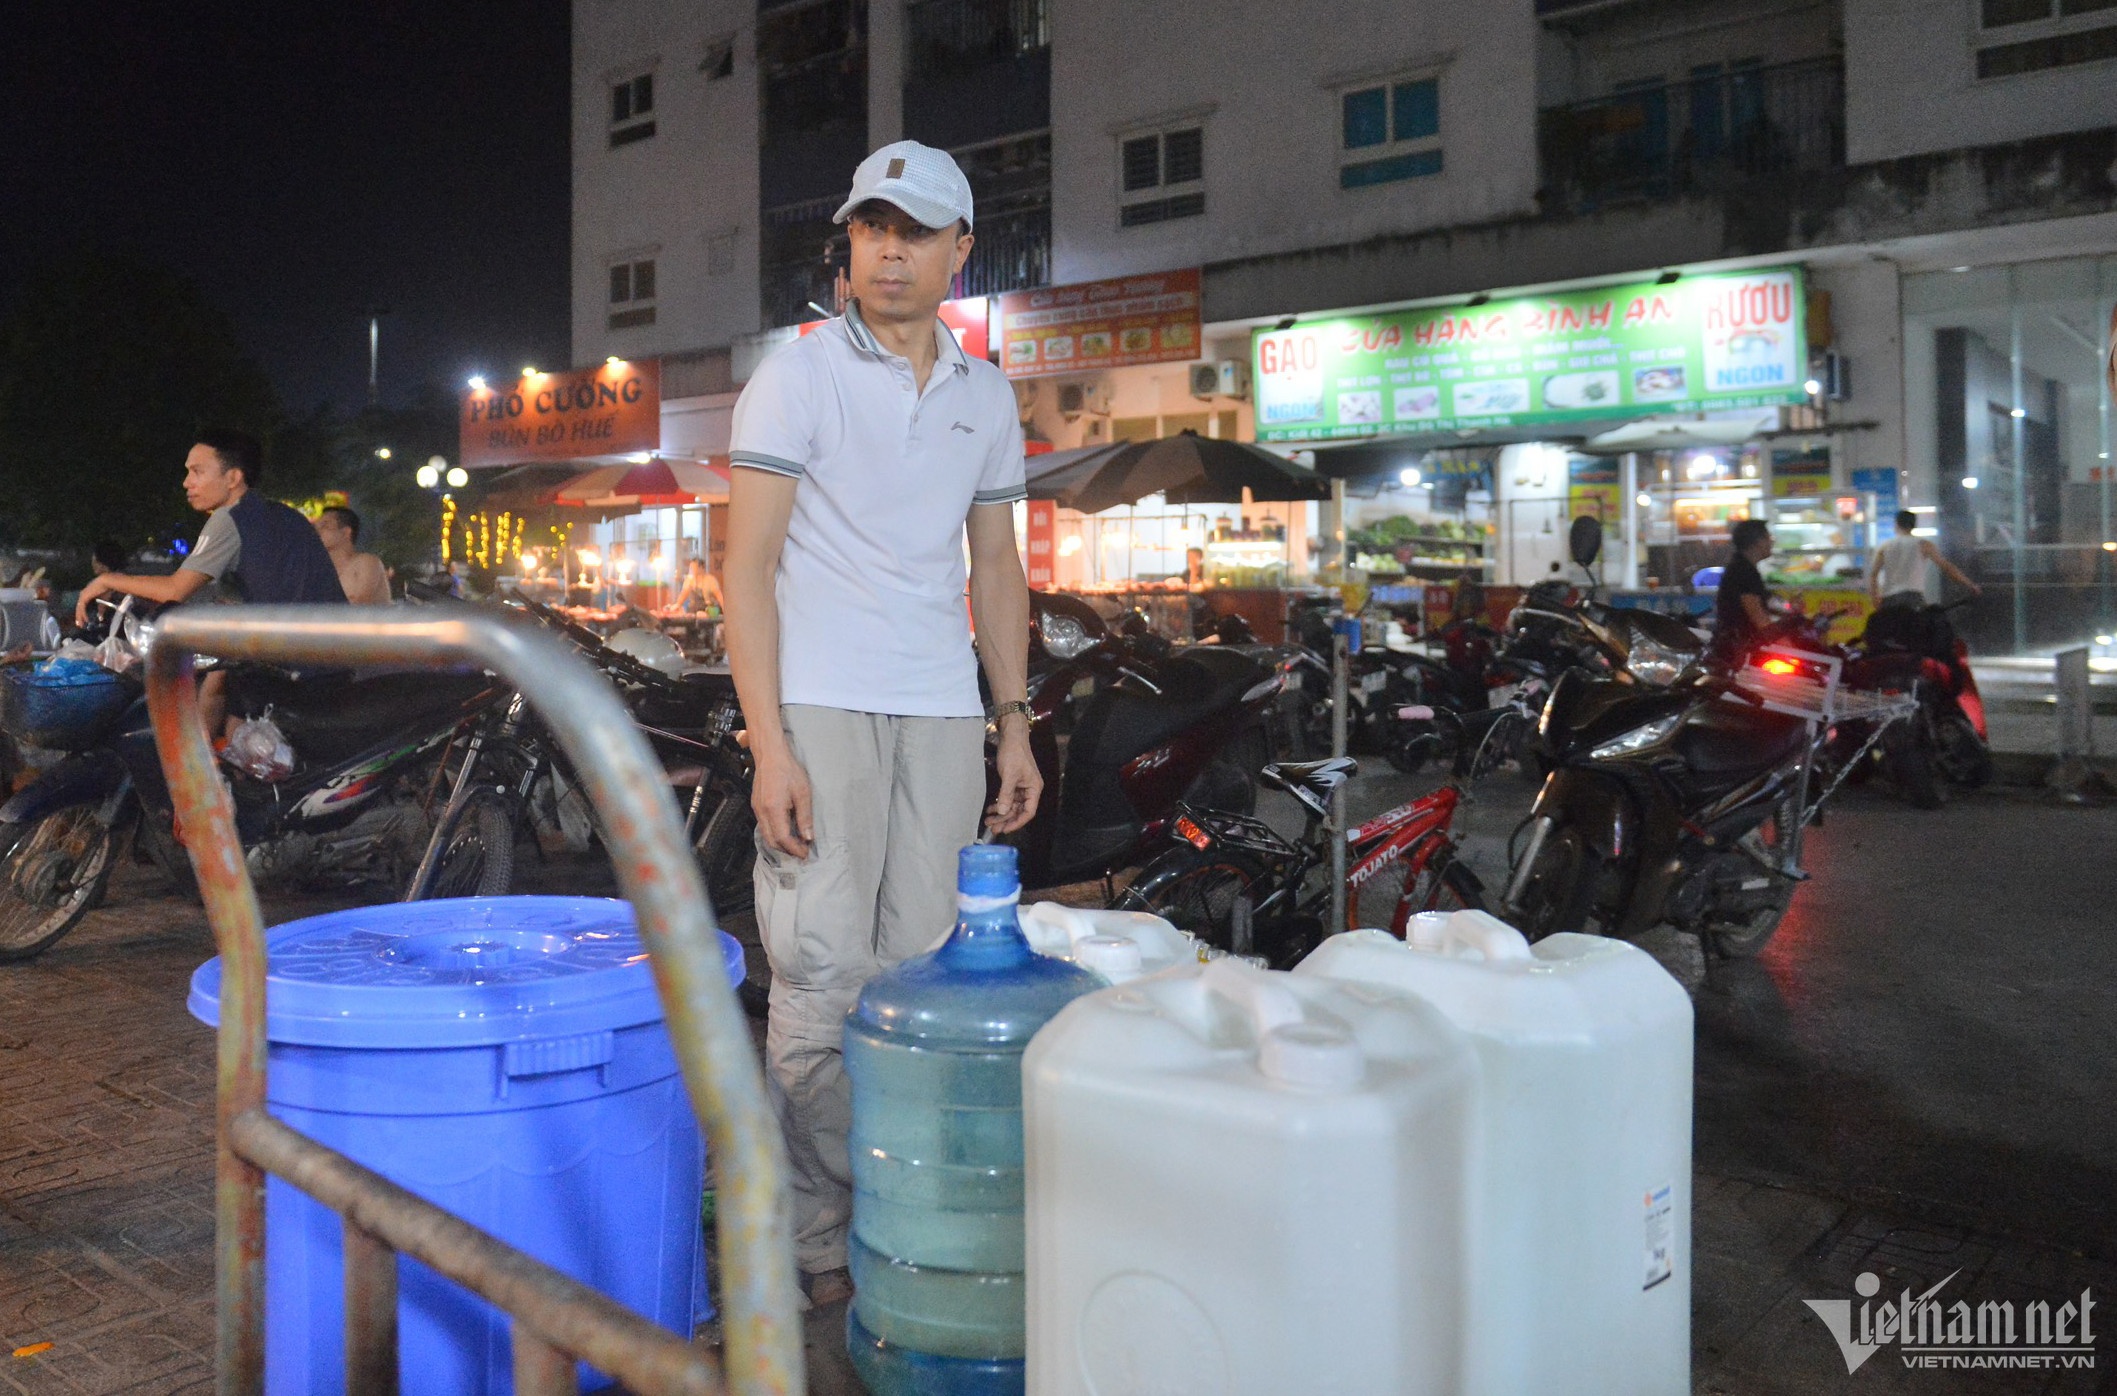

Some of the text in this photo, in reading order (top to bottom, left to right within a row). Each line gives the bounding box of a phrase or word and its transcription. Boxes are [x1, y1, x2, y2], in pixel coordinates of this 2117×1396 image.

[1259, 335, 1318, 381] GẠO
[1716, 362, 1785, 386] NGON
[1350, 844, 1398, 888] TOJATO
